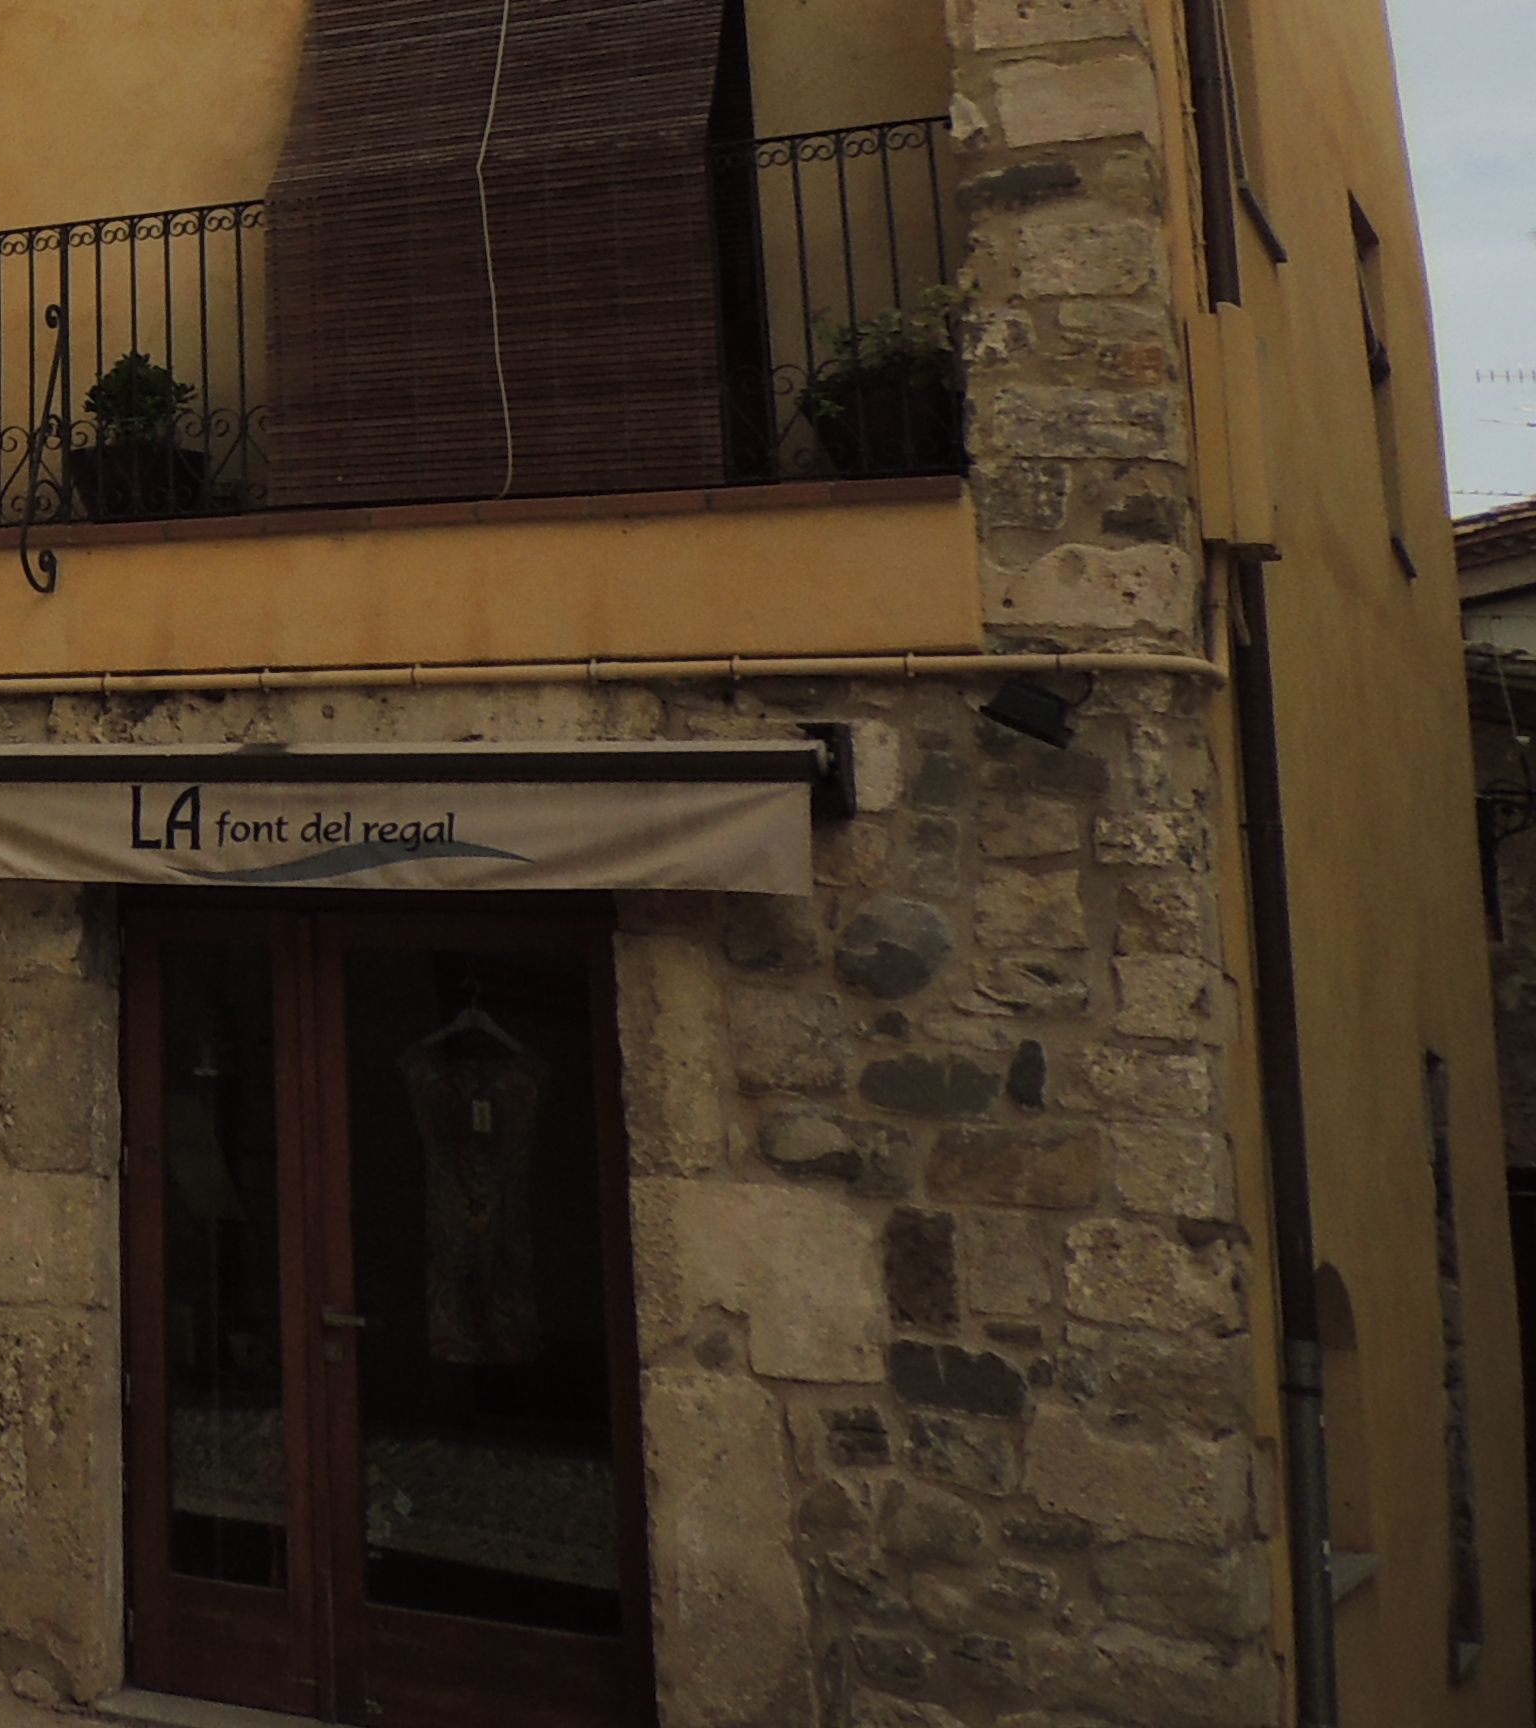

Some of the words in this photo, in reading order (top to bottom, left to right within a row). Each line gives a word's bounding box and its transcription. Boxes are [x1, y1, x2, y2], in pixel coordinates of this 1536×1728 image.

[130, 784, 202, 850] LA
[215, 810, 289, 847] font
[300, 811, 352, 843] del
[361, 812, 455, 852] regal
